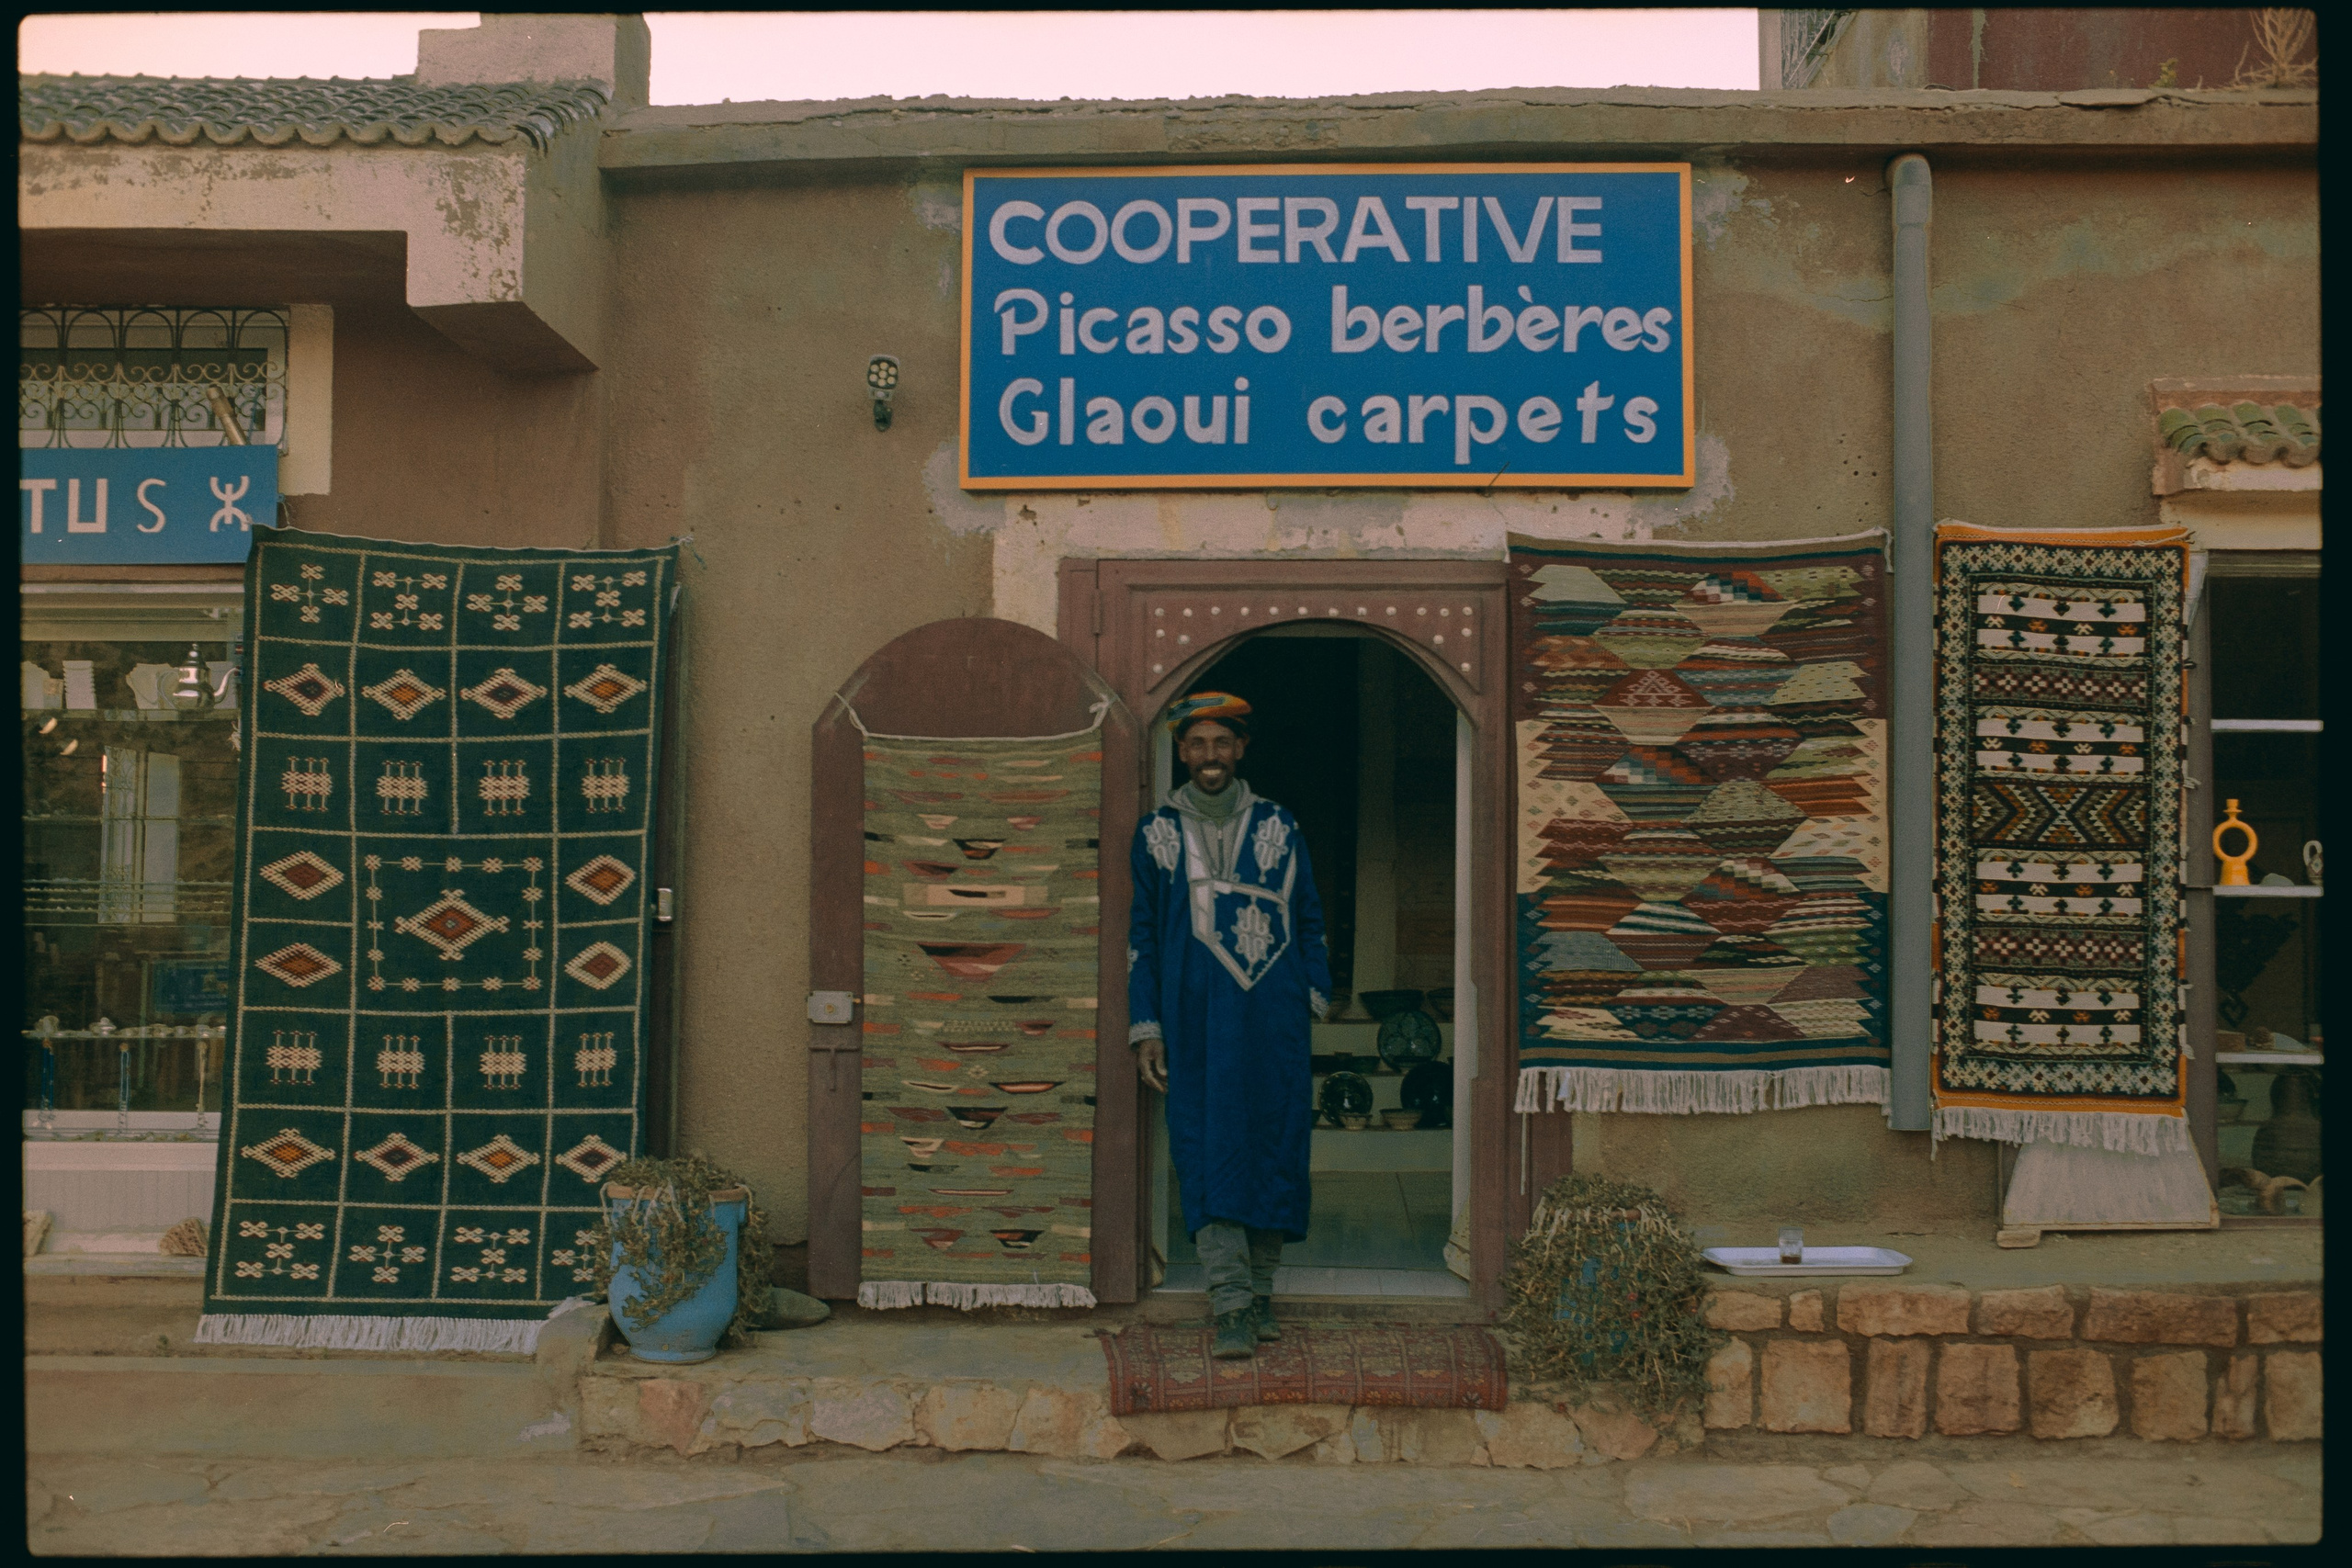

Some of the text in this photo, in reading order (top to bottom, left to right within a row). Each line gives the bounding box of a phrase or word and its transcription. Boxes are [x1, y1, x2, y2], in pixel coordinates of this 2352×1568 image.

[989, 196, 1603, 265] COOPERATIVE
[993, 285, 1672, 356] Picasso berbères
[999, 377, 1659, 465] Glaoui carpets
